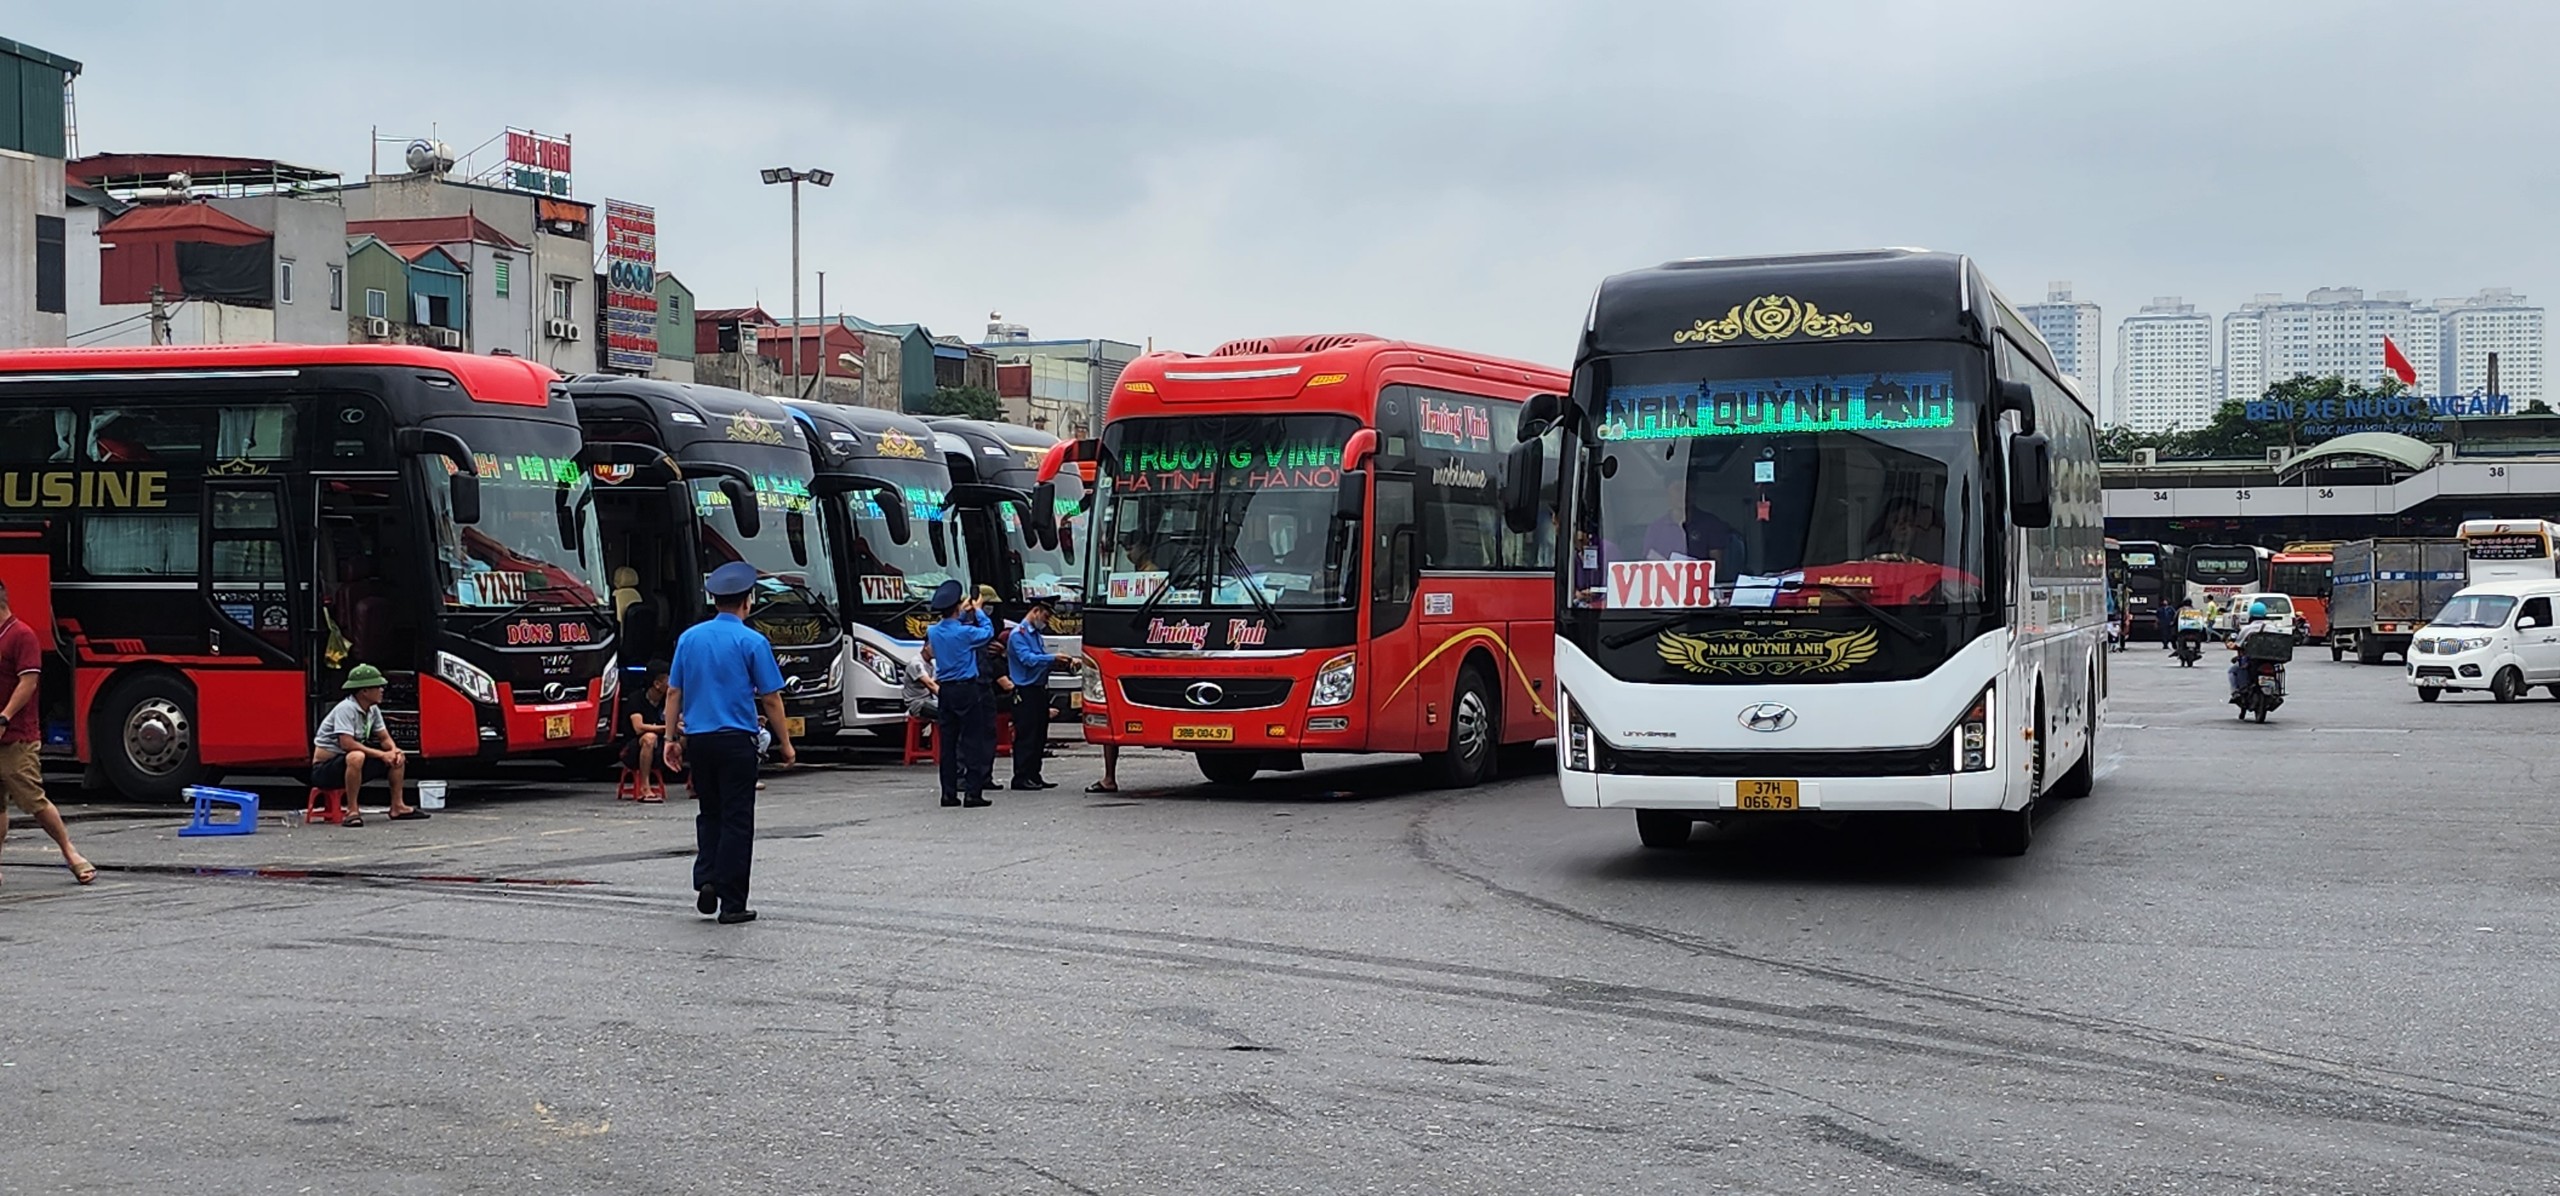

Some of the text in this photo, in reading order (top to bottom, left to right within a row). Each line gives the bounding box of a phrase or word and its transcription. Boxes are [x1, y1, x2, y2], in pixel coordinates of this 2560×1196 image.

[1610, 393, 1698, 428] NAM
[2304, 401, 2336, 418] XE
[2489, 468, 2504, 477] 38
[4, 471, 168, 508] USINE
[2154, 492, 2168, 501] 34
[2236, 491, 2251, 500] 35
[2319, 489, 2334, 498] 36
[474, 572, 523, 604] VINH
[862, 577, 903, 600] VINH
[1611, 562, 1713, 607] VINH
[507, 619, 553, 645] DŨNG
[1709, 643, 1740, 656] NAM
[1794, 642, 1824, 655] ANH
[1754, 782, 1781, 795] 37H
[1744, 796, 1792, 809] 066.79
